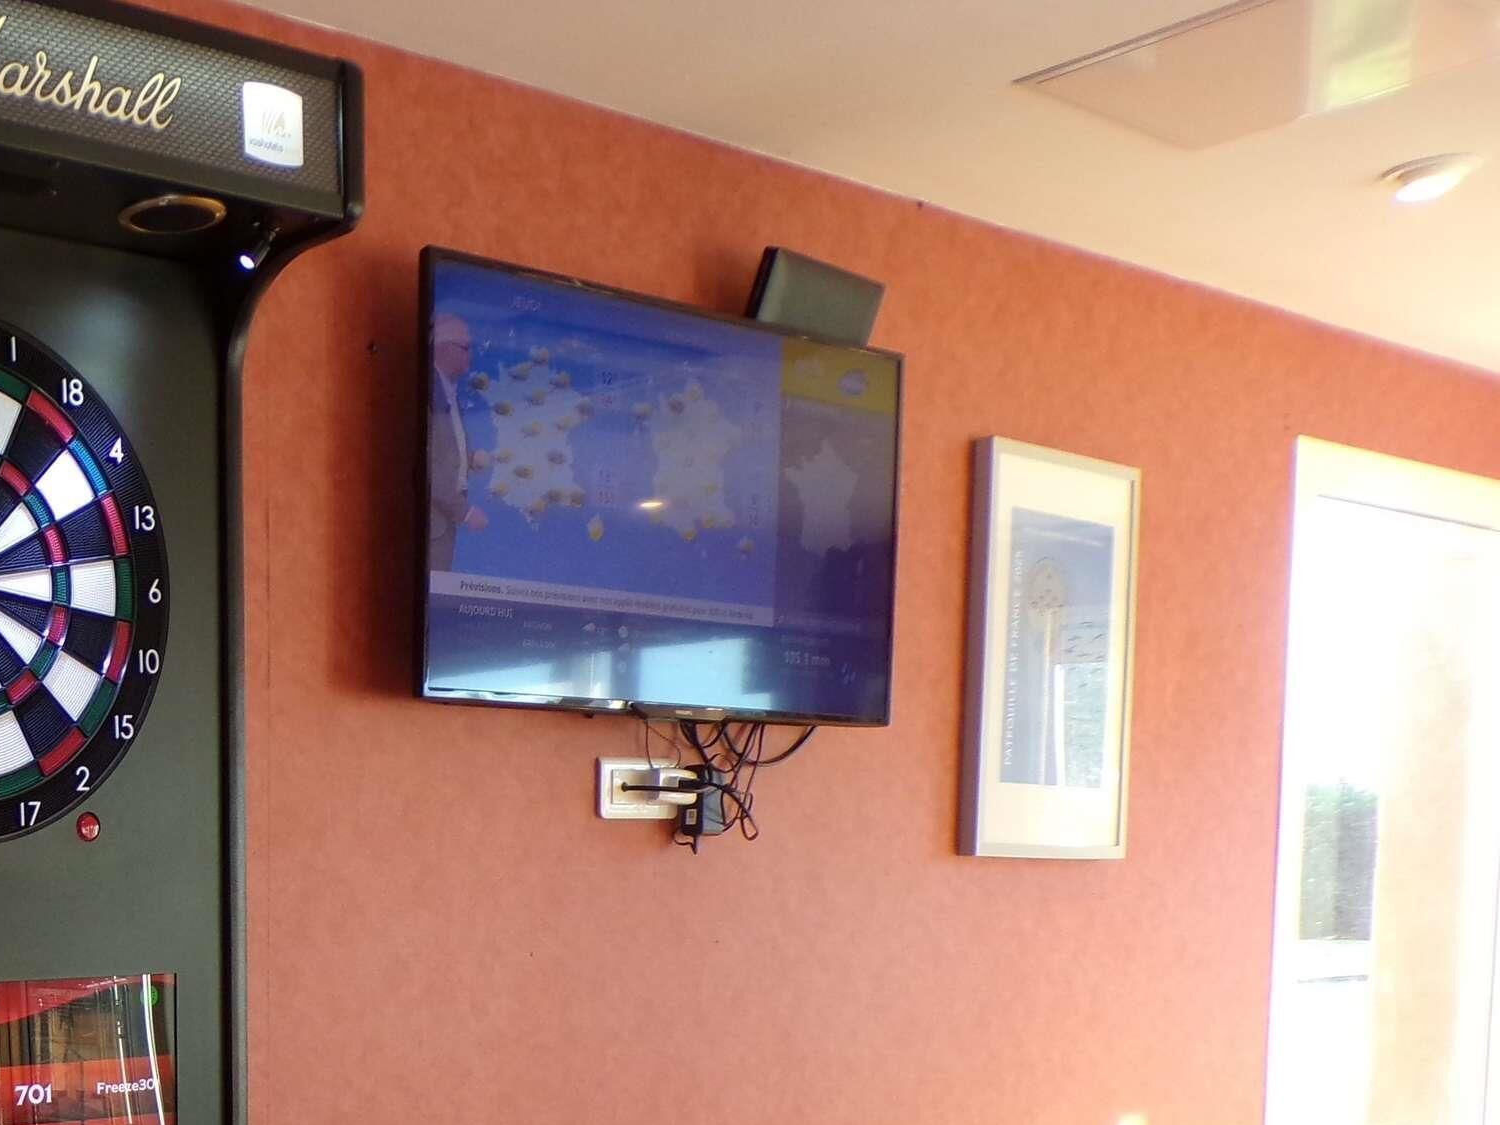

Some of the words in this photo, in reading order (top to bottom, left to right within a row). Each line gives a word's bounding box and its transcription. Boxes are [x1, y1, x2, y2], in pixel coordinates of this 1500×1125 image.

[10, 336, 16, 362] 1
[63, 376, 83, 404] 18
[109, 438, 123, 463] 4
[135, 506, 155, 530] 13
[149, 579, 161, 603] 6
[139, 649, 159, 673] 10
[115, 715, 134, 739] 15
[76, 766, 90, 791] 2
[21, 801, 41, 828] 17
[14, 1084, 53, 1106] 701
